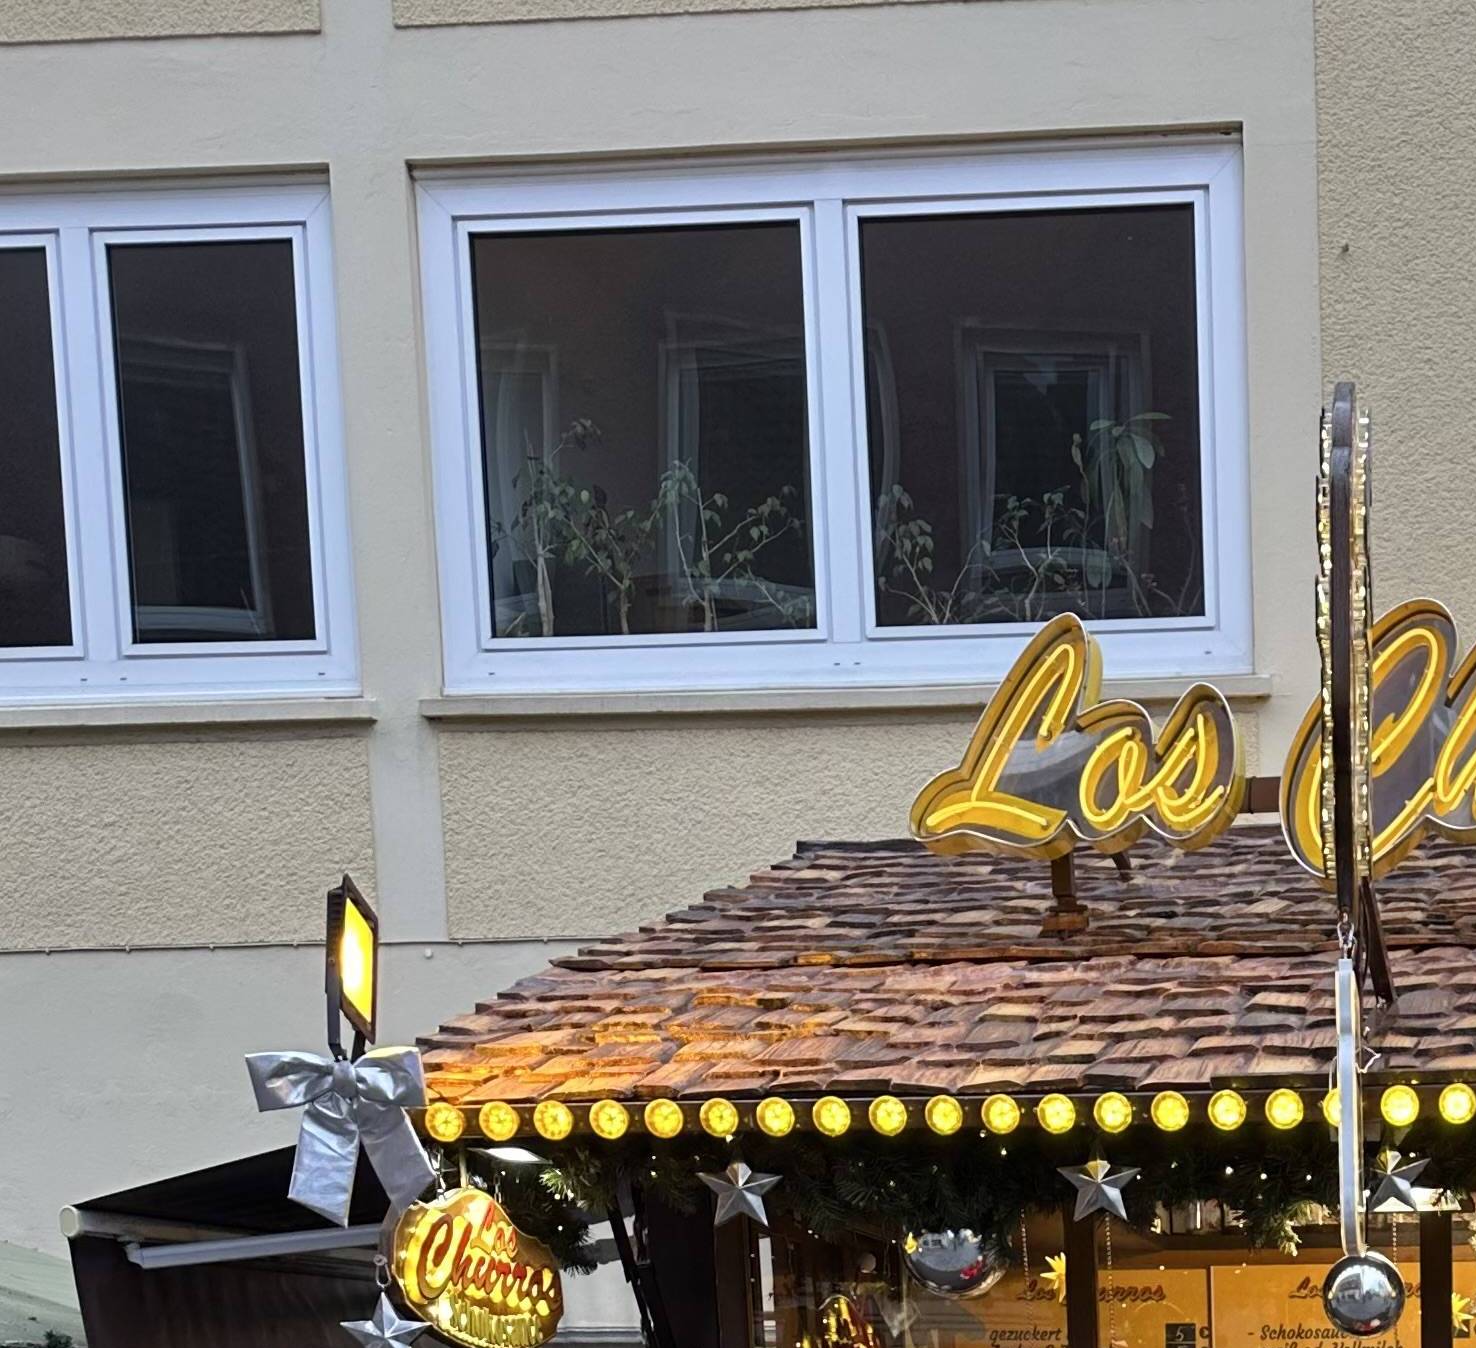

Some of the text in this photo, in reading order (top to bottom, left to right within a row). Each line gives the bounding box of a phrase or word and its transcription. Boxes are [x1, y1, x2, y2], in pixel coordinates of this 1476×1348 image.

[918, 636, 1238, 850] Los
[470, 1200, 518, 1258] Los
[989, 1327, 1062, 1344] gezuckert
